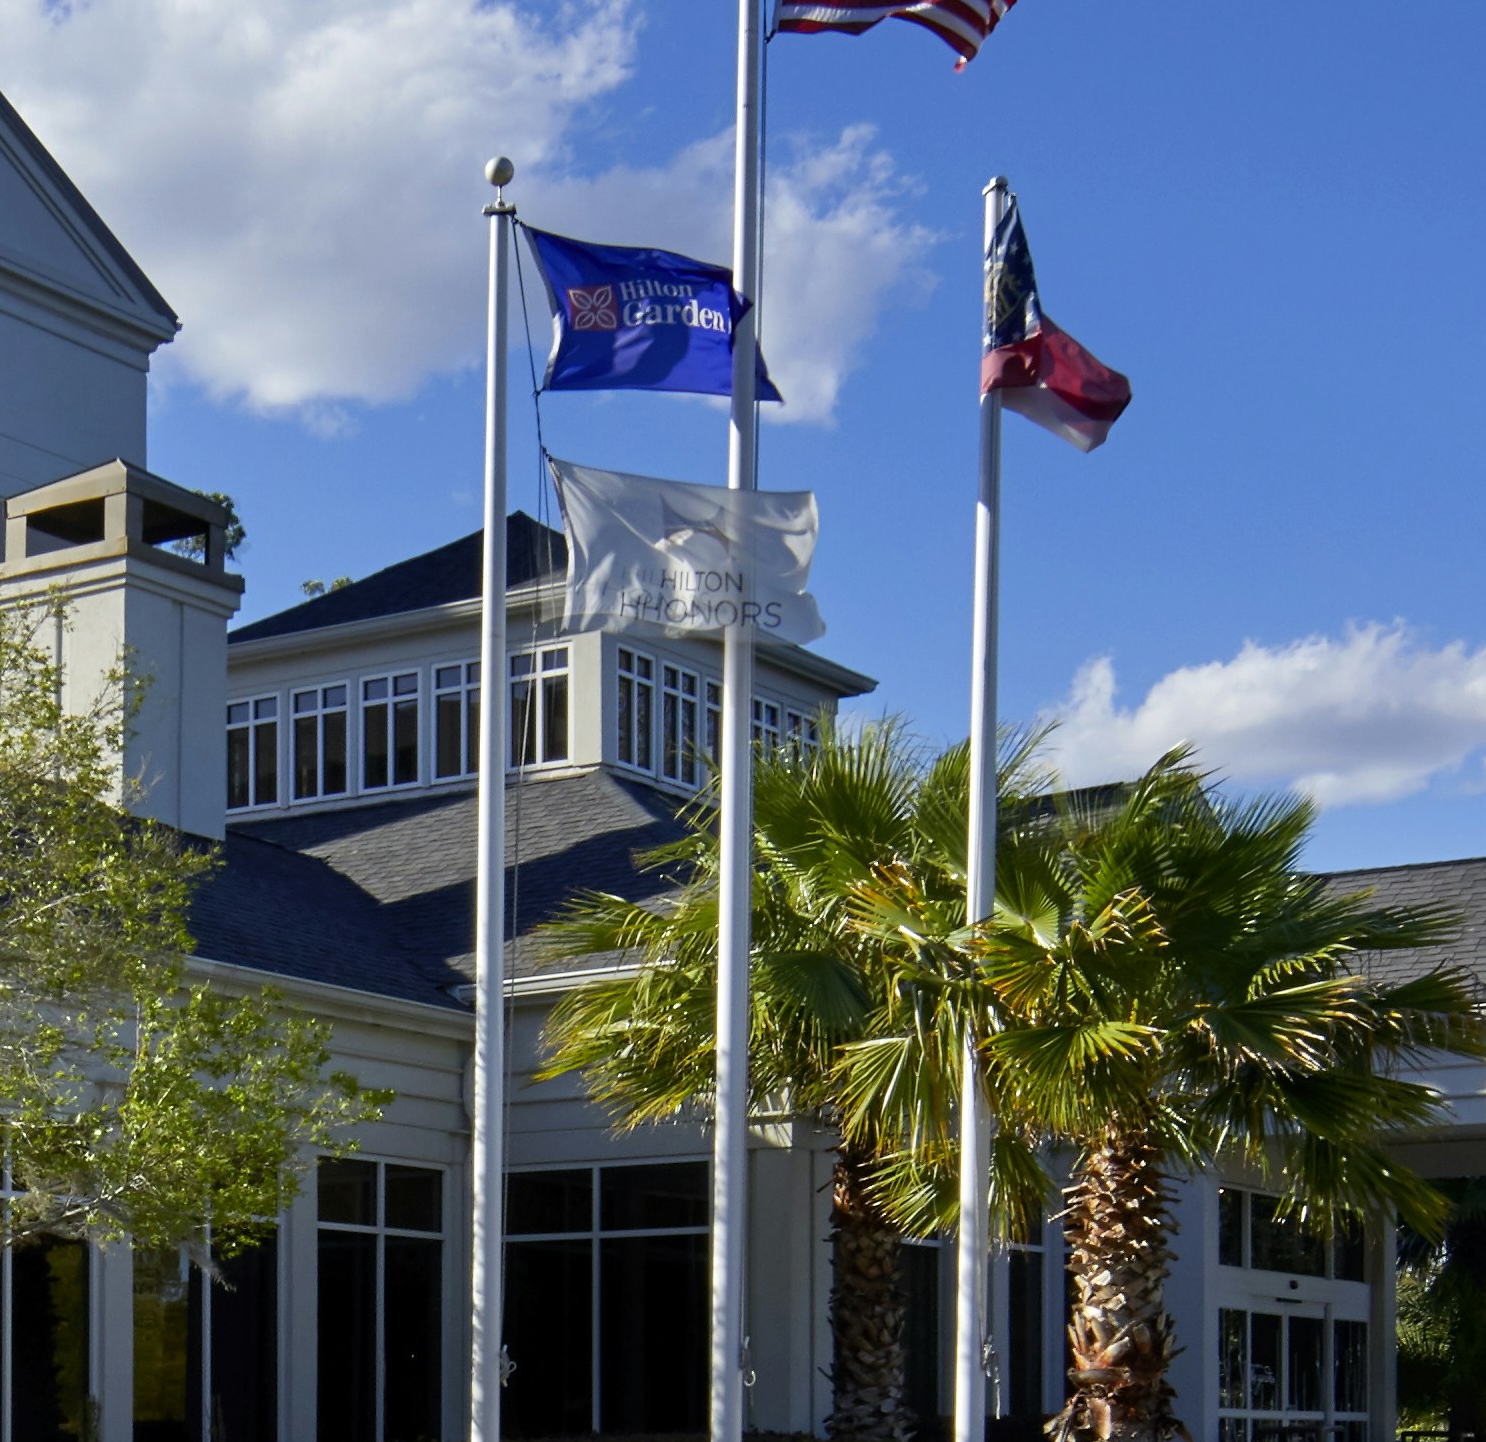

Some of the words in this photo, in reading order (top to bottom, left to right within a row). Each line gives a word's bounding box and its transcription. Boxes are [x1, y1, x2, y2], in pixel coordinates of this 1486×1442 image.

[619, 279, 693, 301] Hilton
[623, 299, 726, 333] Garden
[661, 568, 744, 593] HILTON
